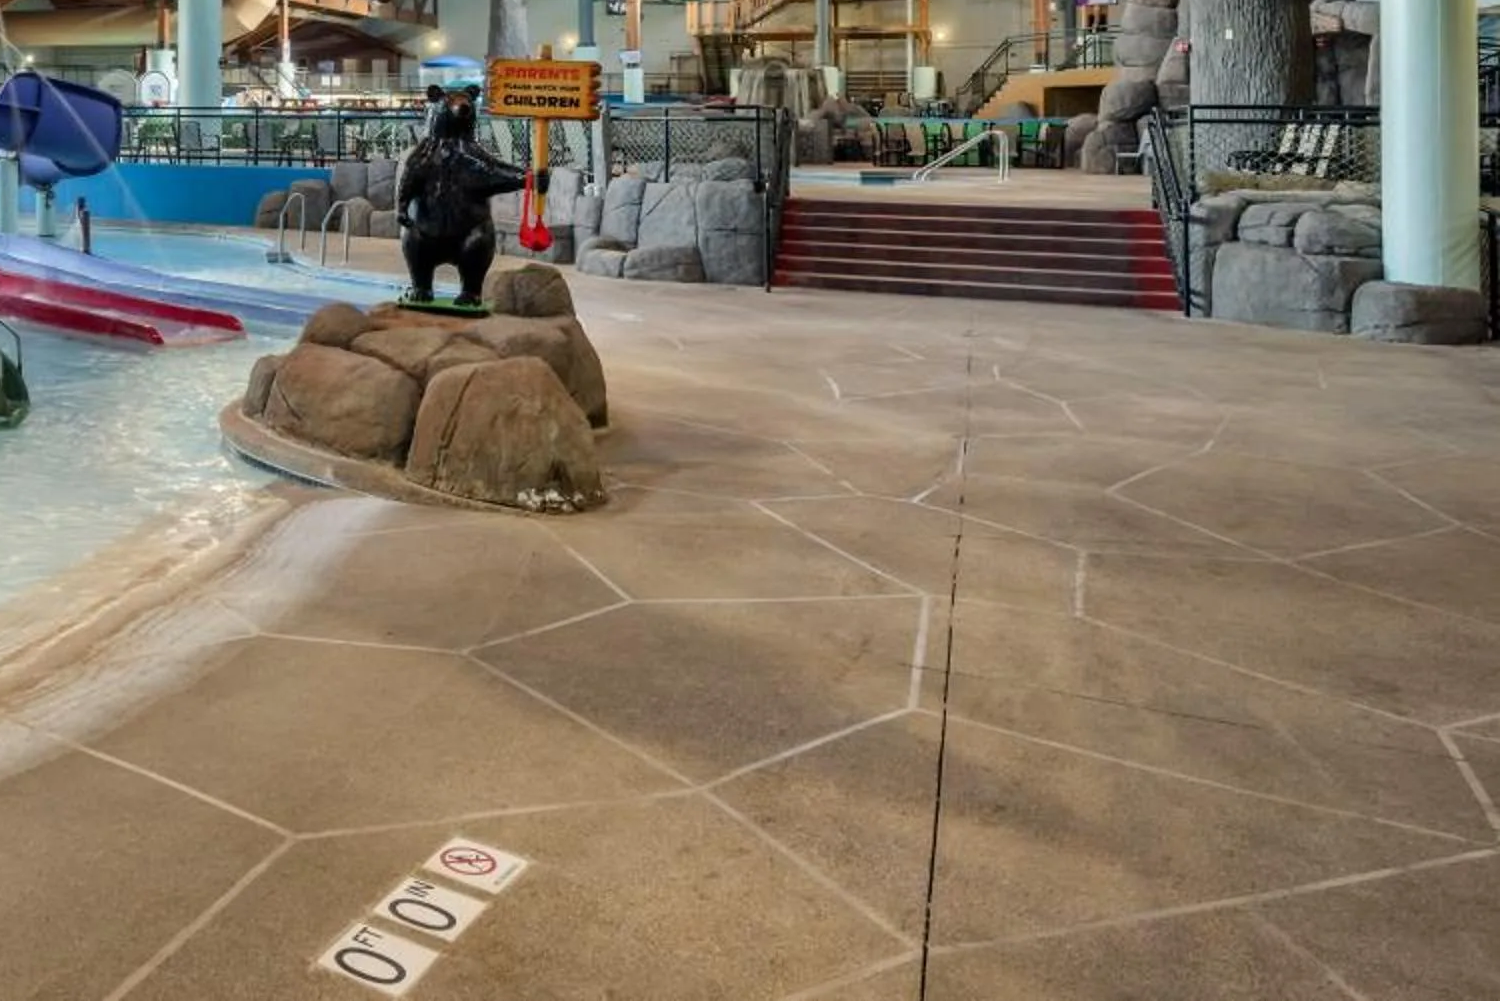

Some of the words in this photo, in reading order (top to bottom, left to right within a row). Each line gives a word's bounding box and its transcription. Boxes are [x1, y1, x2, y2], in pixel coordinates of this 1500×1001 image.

[503, 66, 581, 80] PARENTS
[503, 94, 581, 108] CHILDREN
[351, 926, 384, 948] FT
[404, 879, 436, 898] IN
